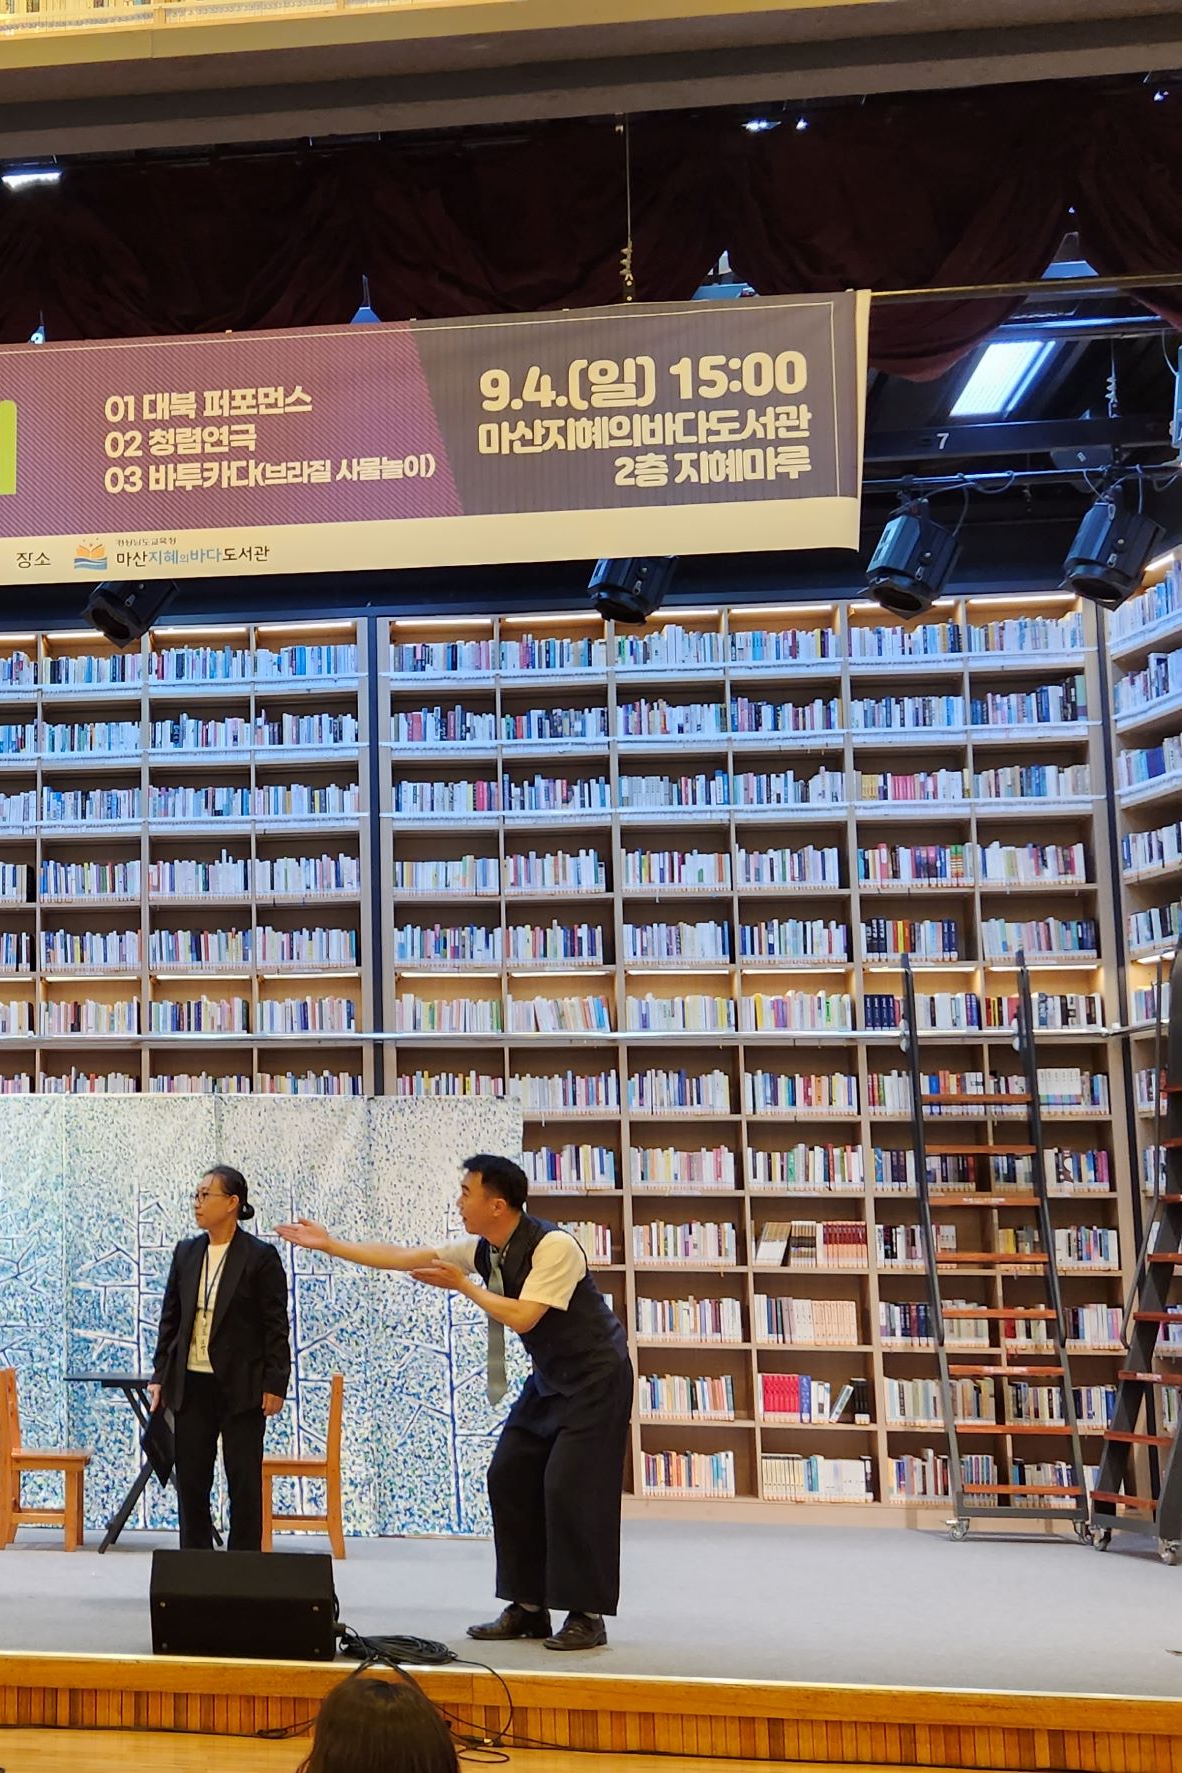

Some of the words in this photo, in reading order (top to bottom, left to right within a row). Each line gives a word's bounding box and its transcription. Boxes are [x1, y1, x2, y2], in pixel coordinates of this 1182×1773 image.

[479, 355, 656, 412] 9.4.(일)
[668, 350, 807, 400] 15:00
[104, 395, 135, 423] 01
[142, 391, 197, 421] 대북
[203, 385, 313, 418] 퍼포먼스
[104, 430, 143, 458] 02
[148, 423, 257, 456] 청렴연극
[478, 404, 812, 455] 마산지혜의바다도서관
[936, 432, 950, 450] 7
[104, 466, 143, 494] 03
[335, 452, 436, 483] 사물놀이)
[614, 453, 668, 488] 2층
[674, 444, 812, 485] 지혜마루
[16, 551, 51, 569] 장소
[116, 545, 270, 568] 마산지혜의바다도서관
